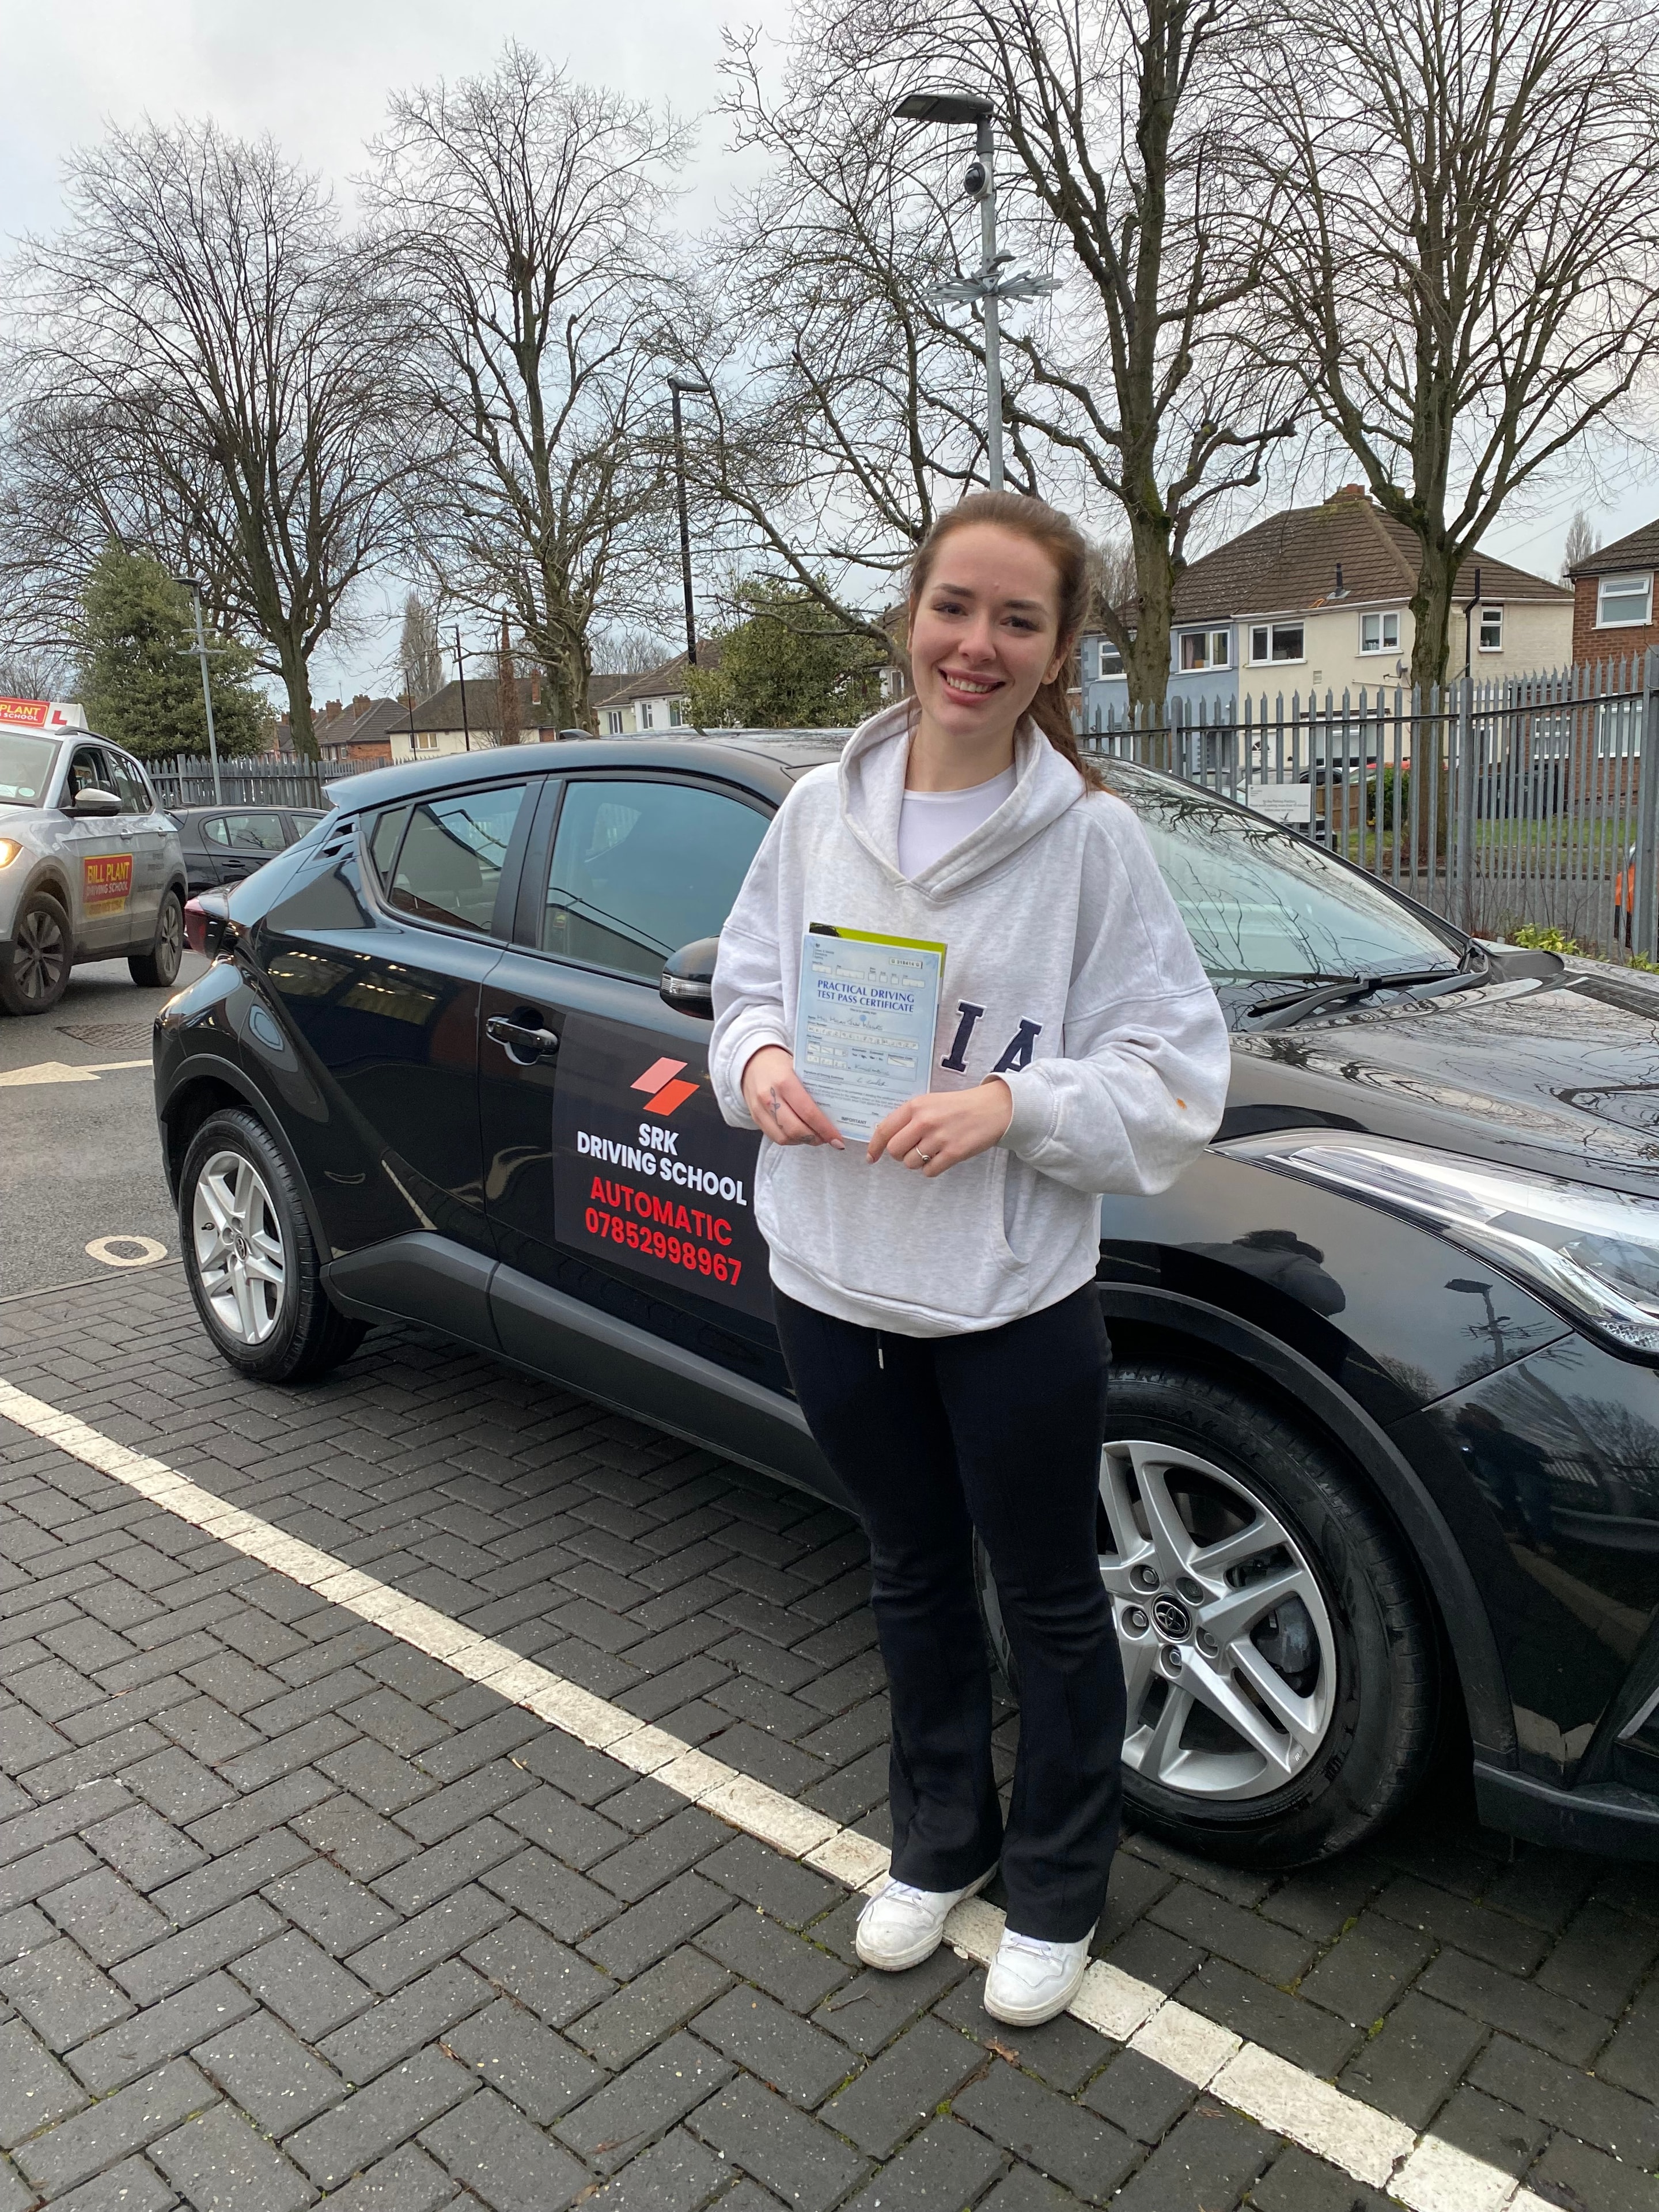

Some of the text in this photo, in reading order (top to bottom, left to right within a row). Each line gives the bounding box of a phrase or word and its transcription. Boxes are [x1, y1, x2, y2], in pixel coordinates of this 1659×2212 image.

[0, 704, 41, 716] PLANT
[3, 713, 38, 721] SCHOOL
[51, 710, 67, 725] L
[88, 862, 130, 884] BILL PLANT
[86, 883, 108, 896] DRIVING
[108, 881, 128, 893] SCHOOL
[817, 980, 914, 1003] PRACTICAL DRIVING
[817, 990, 835, 1000] TEST
[838, 993, 857, 1004] PASS
[859, 997, 914, 1013] CERTIFICATE
[841, 1116, 866, 1124] IMPORTANT
[638, 1123, 679, 1156] SRK
[577, 1131, 747, 1206] DRIVING SCHOOL
[590, 1176, 733, 1247] AUTOMATIC
[585, 1207, 742, 1286] 07852998967
